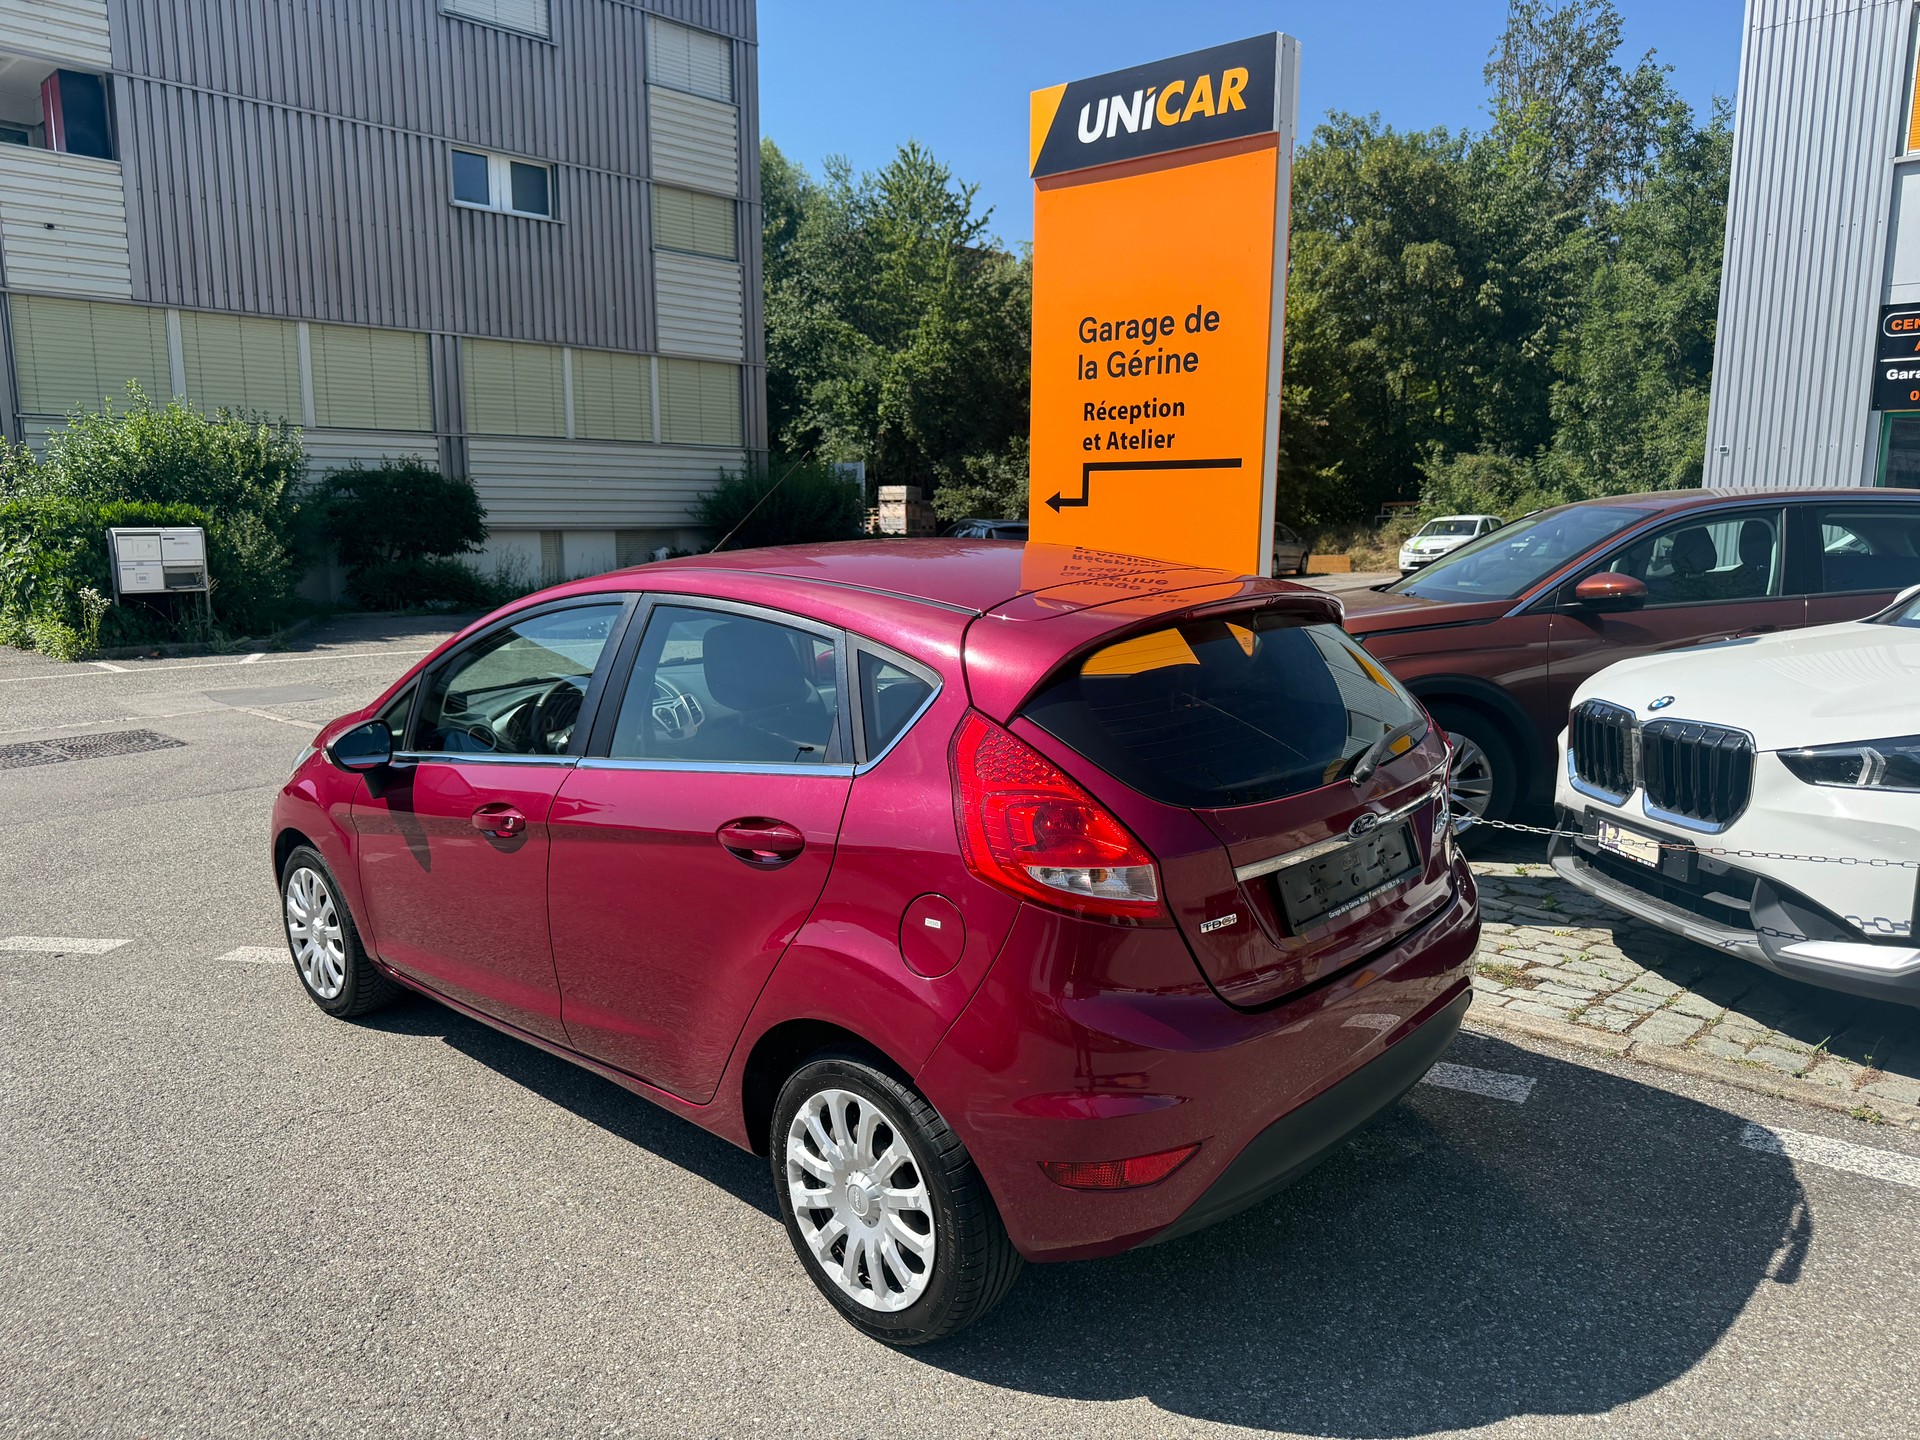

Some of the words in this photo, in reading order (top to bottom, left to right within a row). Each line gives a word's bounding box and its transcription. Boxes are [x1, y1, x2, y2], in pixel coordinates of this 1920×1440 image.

[1078, 316, 1175, 346] Garage
[1184, 304, 1220, 334] de
[1078, 354, 1098, 381] la
[1106, 347, 1199, 379] Gérine
[1083, 397, 1185, 425] Réception
[1082, 433, 1101, 451] et
[1106, 428, 1176, 450] Atelier
